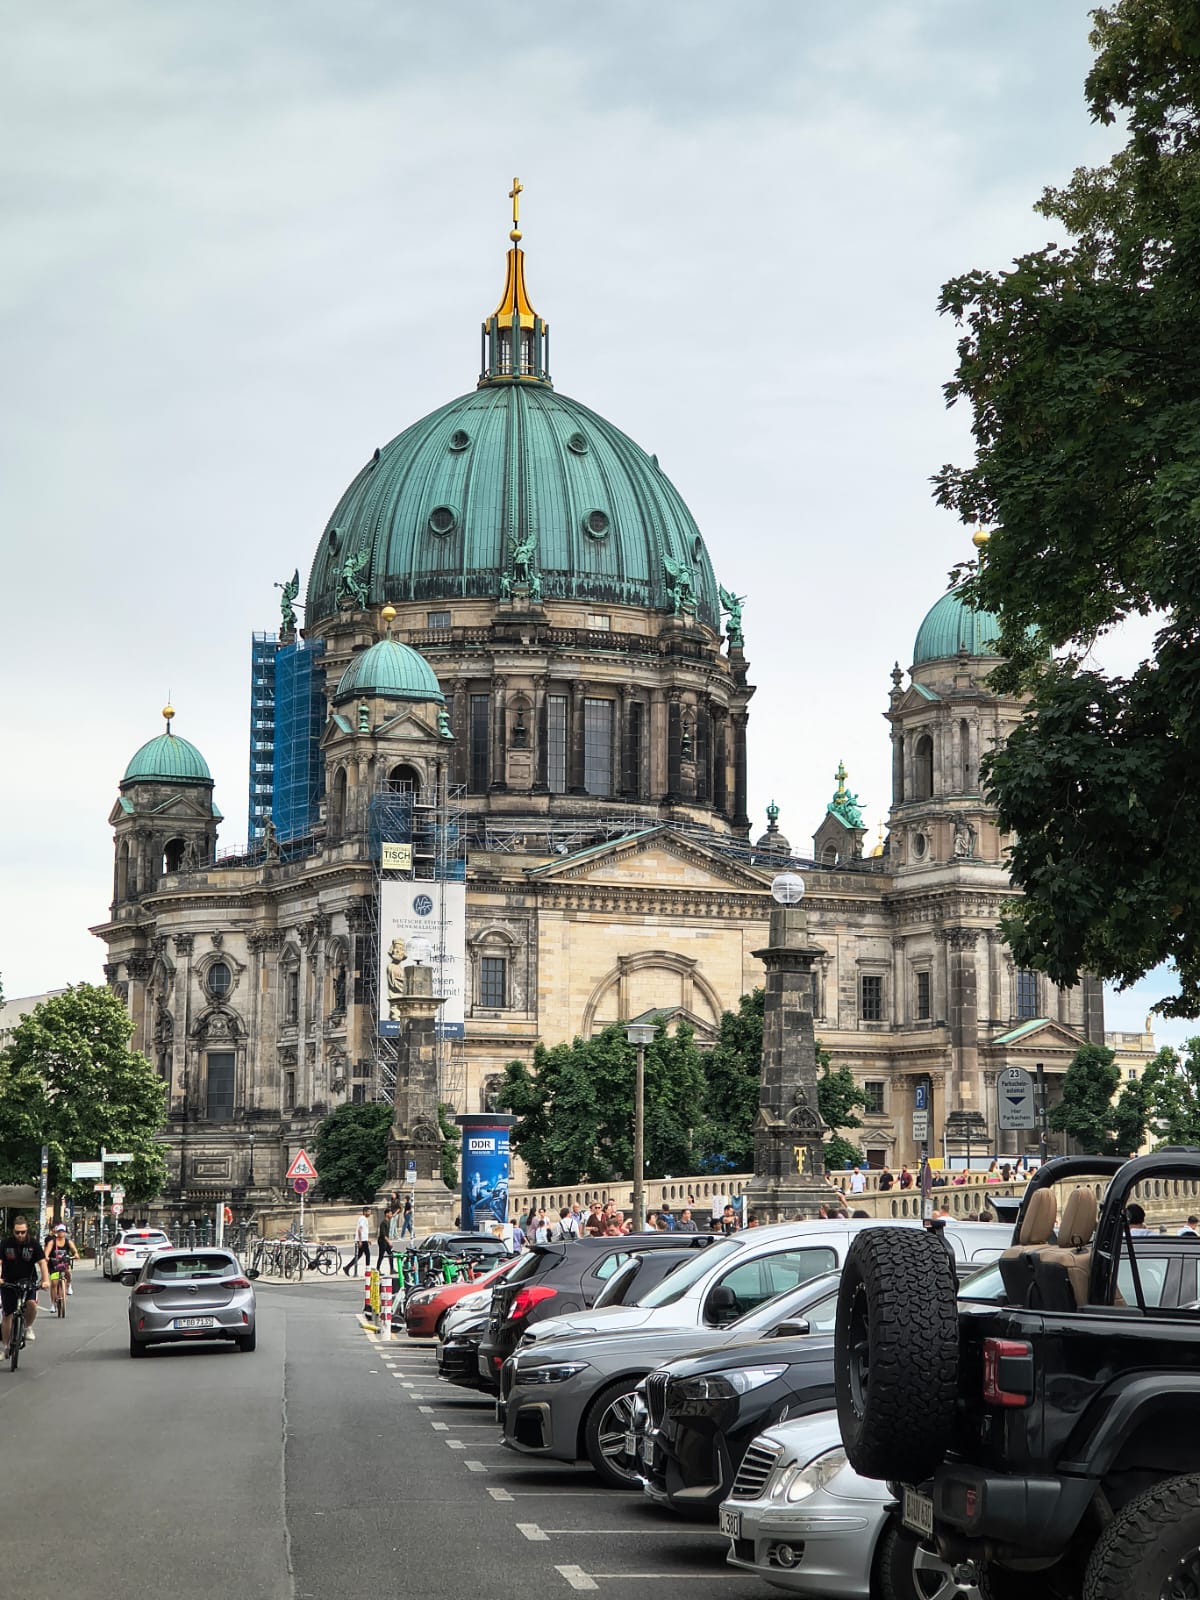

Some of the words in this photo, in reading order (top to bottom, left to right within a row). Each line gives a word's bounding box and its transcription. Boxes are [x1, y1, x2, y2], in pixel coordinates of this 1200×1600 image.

[384, 850, 410, 860] TISCH
[1009, 1069, 1020, 1078] 23
[471, 1140, 491, 1149] DDR
